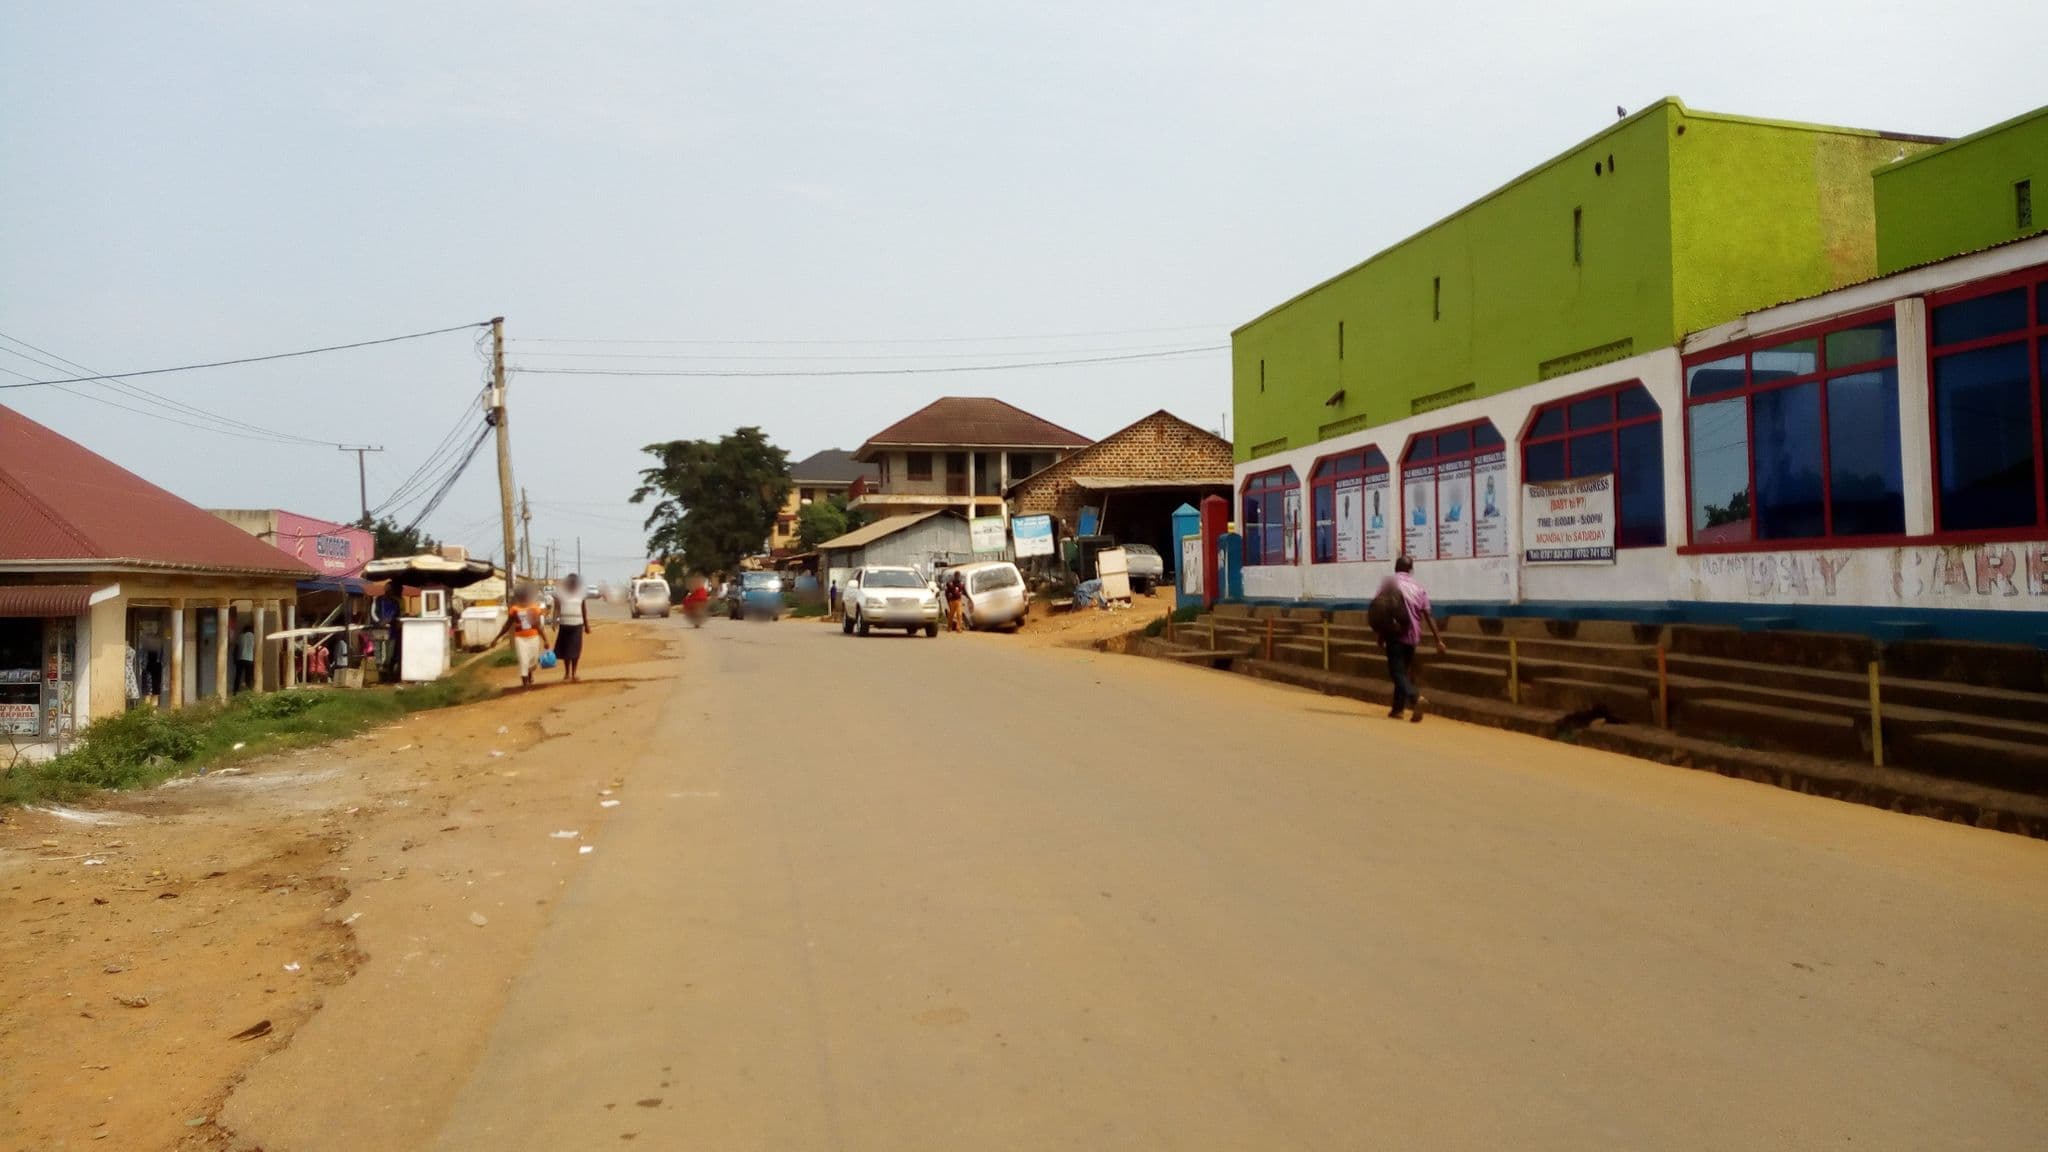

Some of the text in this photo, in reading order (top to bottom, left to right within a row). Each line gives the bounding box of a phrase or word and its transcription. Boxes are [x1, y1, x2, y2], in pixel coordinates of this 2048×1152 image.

[1576, 479, 1609, 494] PROGRESS
[1536, 532, 1564, 544] MONDAY
[1574, 529, 1606, 542] SATURDAY
